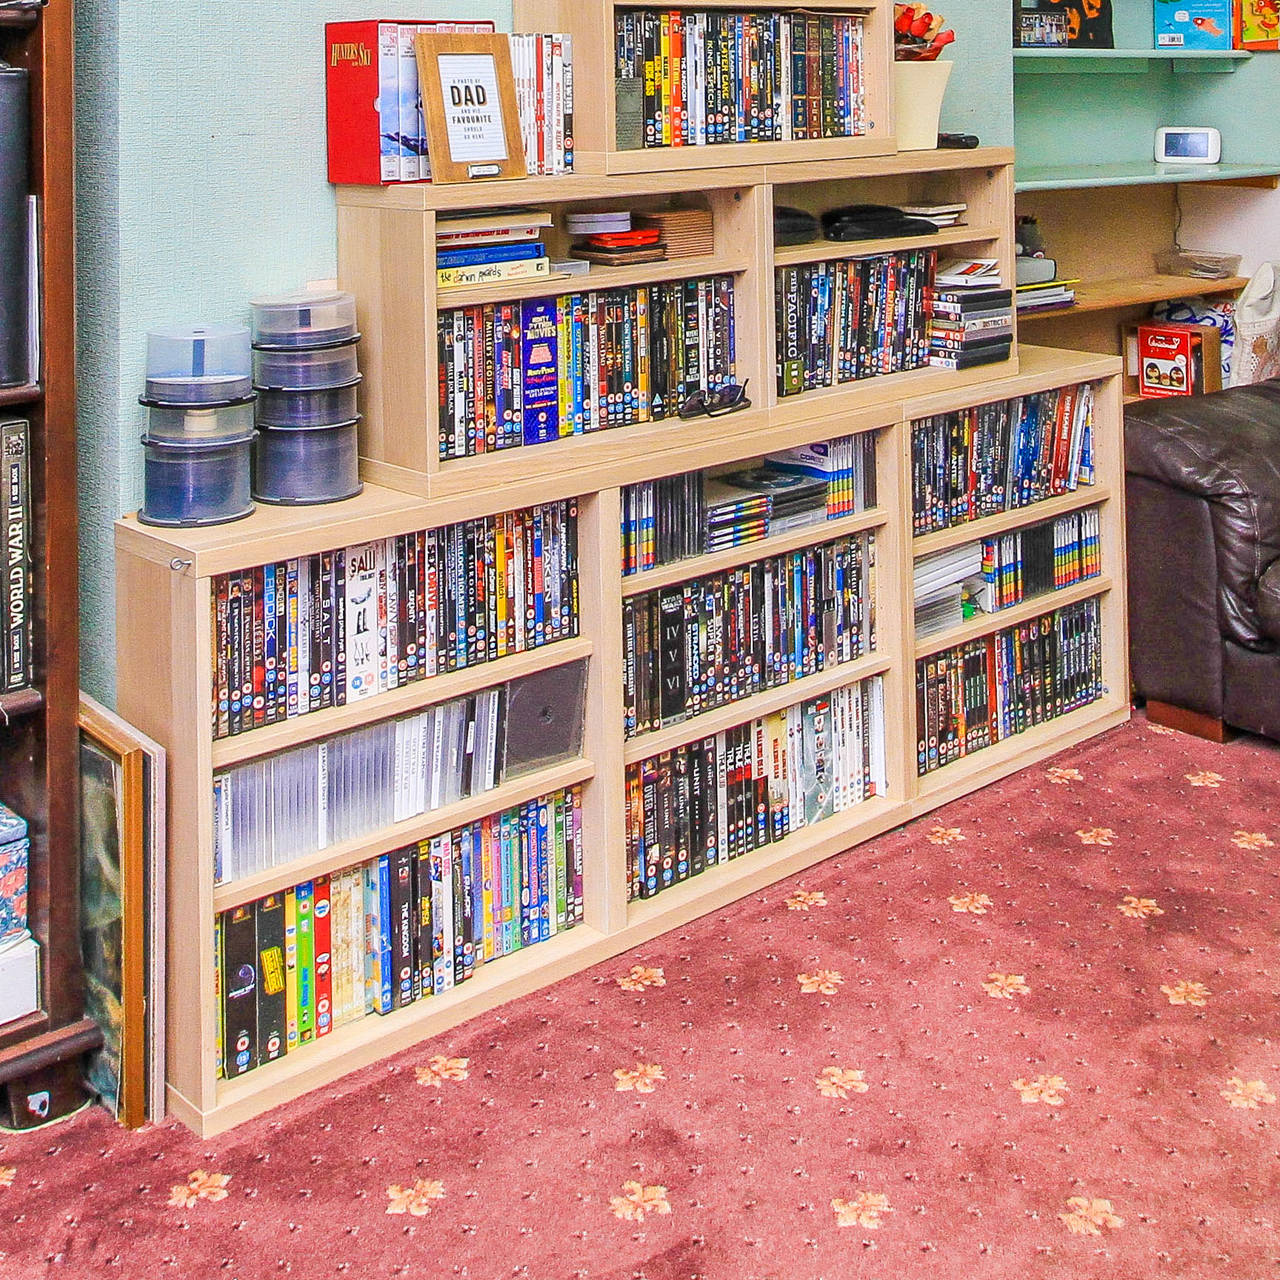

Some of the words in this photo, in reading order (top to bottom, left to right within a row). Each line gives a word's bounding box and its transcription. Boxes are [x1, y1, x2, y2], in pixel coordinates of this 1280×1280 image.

[331, 43, 358, 67] HUNTERS
[359, 42, 372, 67] SKY
[645, 60, 654, 97] KICK-ASS
[721, 74, 729, 99] CAKE
[450, 84, 487, 107] DAD
[452, 115, 492, 124] FAVOURITE
[907, 277, 915, 329] QUARANTINE
[624, 323, 631, 334] ON
[787, 293, 798, 358] PACIFIC
[983, 318, 1003, 328] DISTRICT
[485, 321, 493, 357] MILLER'S
[8, 505, 23, 520] II
[7, 520, 23, 566] WAR
[457, 526, 465, 577] SHERLOCK
[560, 522, 568, 571] UNKNOWN
[427, 545, 437, 571] SEX
[544, 544, 552, 602] TAKEN
[9, 568, 24, 630] WORLD
[388, 592, 398, 616] SAW
[428, 571, 437, 611] DRIVE
[457, 578, 465, 617] HOLMES
[265, 578, 276, 641] RIDDICK
[322, 598, 331, 645] SALT
[626, 623, 634, 637] STAR
[666, 624, 680, 640] IV
[669, 649, 678, 662] V
[666, 675, 680, 690] VI
[726, 747, 734, 773] TRUE
[735, 743, 743, 769] TRUE
[644, 783, 654, 811] OVER
[566, 811, 574, 841] TRAINS
[644, 816, 654, 847] THERE
[442, 841, 450, 856] WAR
[557, 864, 565, 900] ARROW
